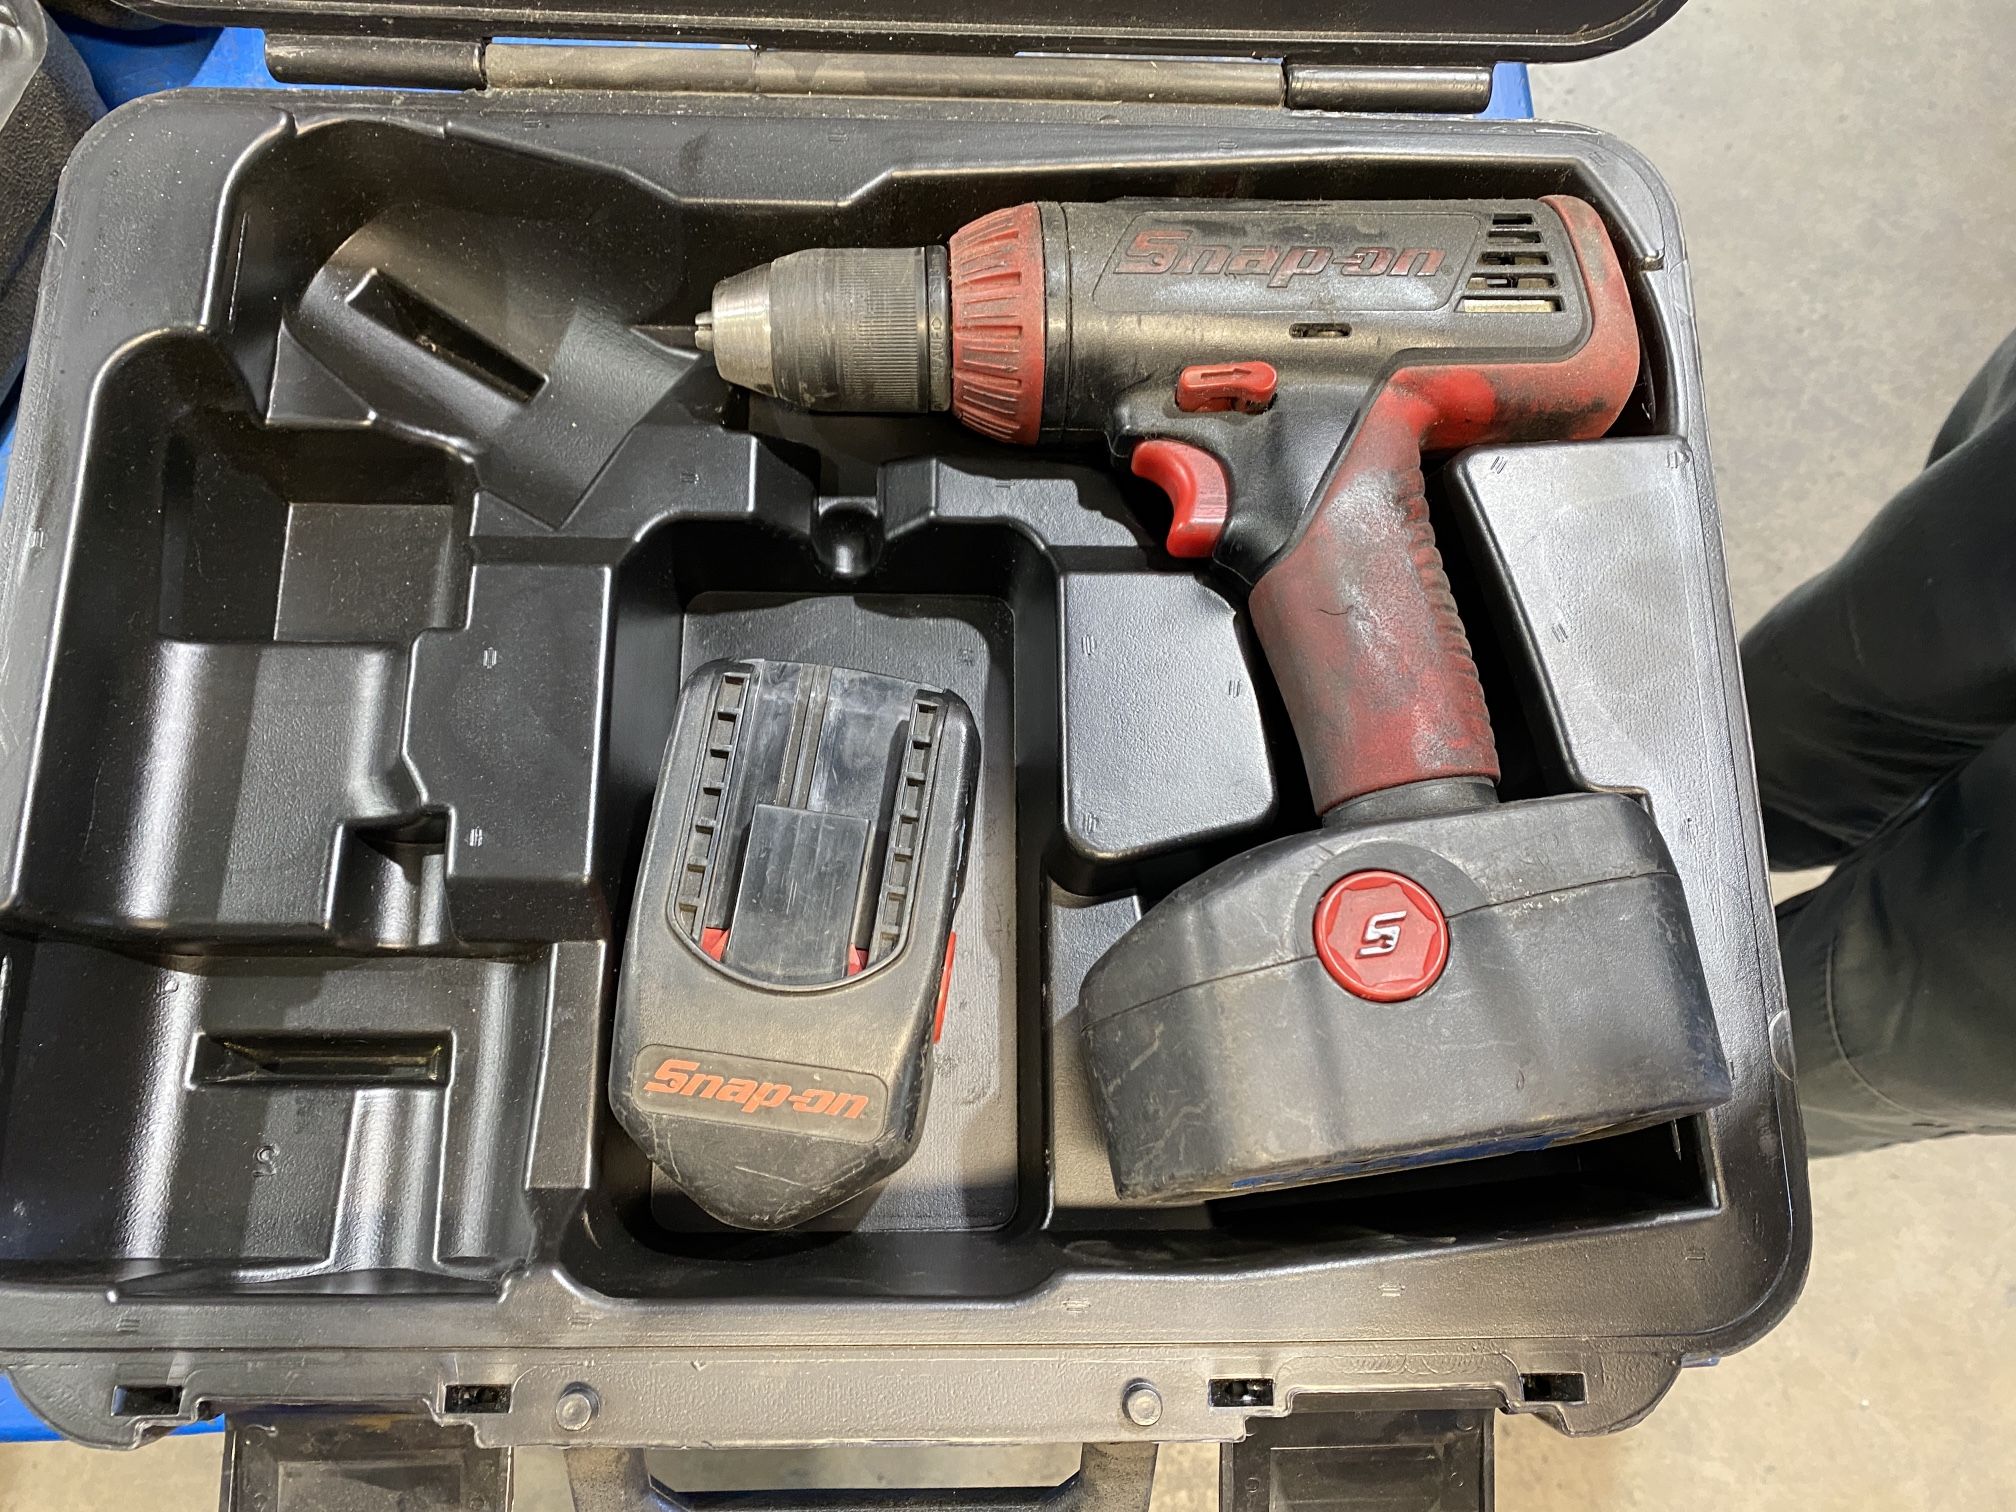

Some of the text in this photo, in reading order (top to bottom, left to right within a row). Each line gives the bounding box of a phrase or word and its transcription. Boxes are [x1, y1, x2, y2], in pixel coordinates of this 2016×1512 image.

[1112, 229, 1446, 289] Snap-on
[1355, 909, 1407, 960] S
[643, 1059, 869, 1119] Snap-on
